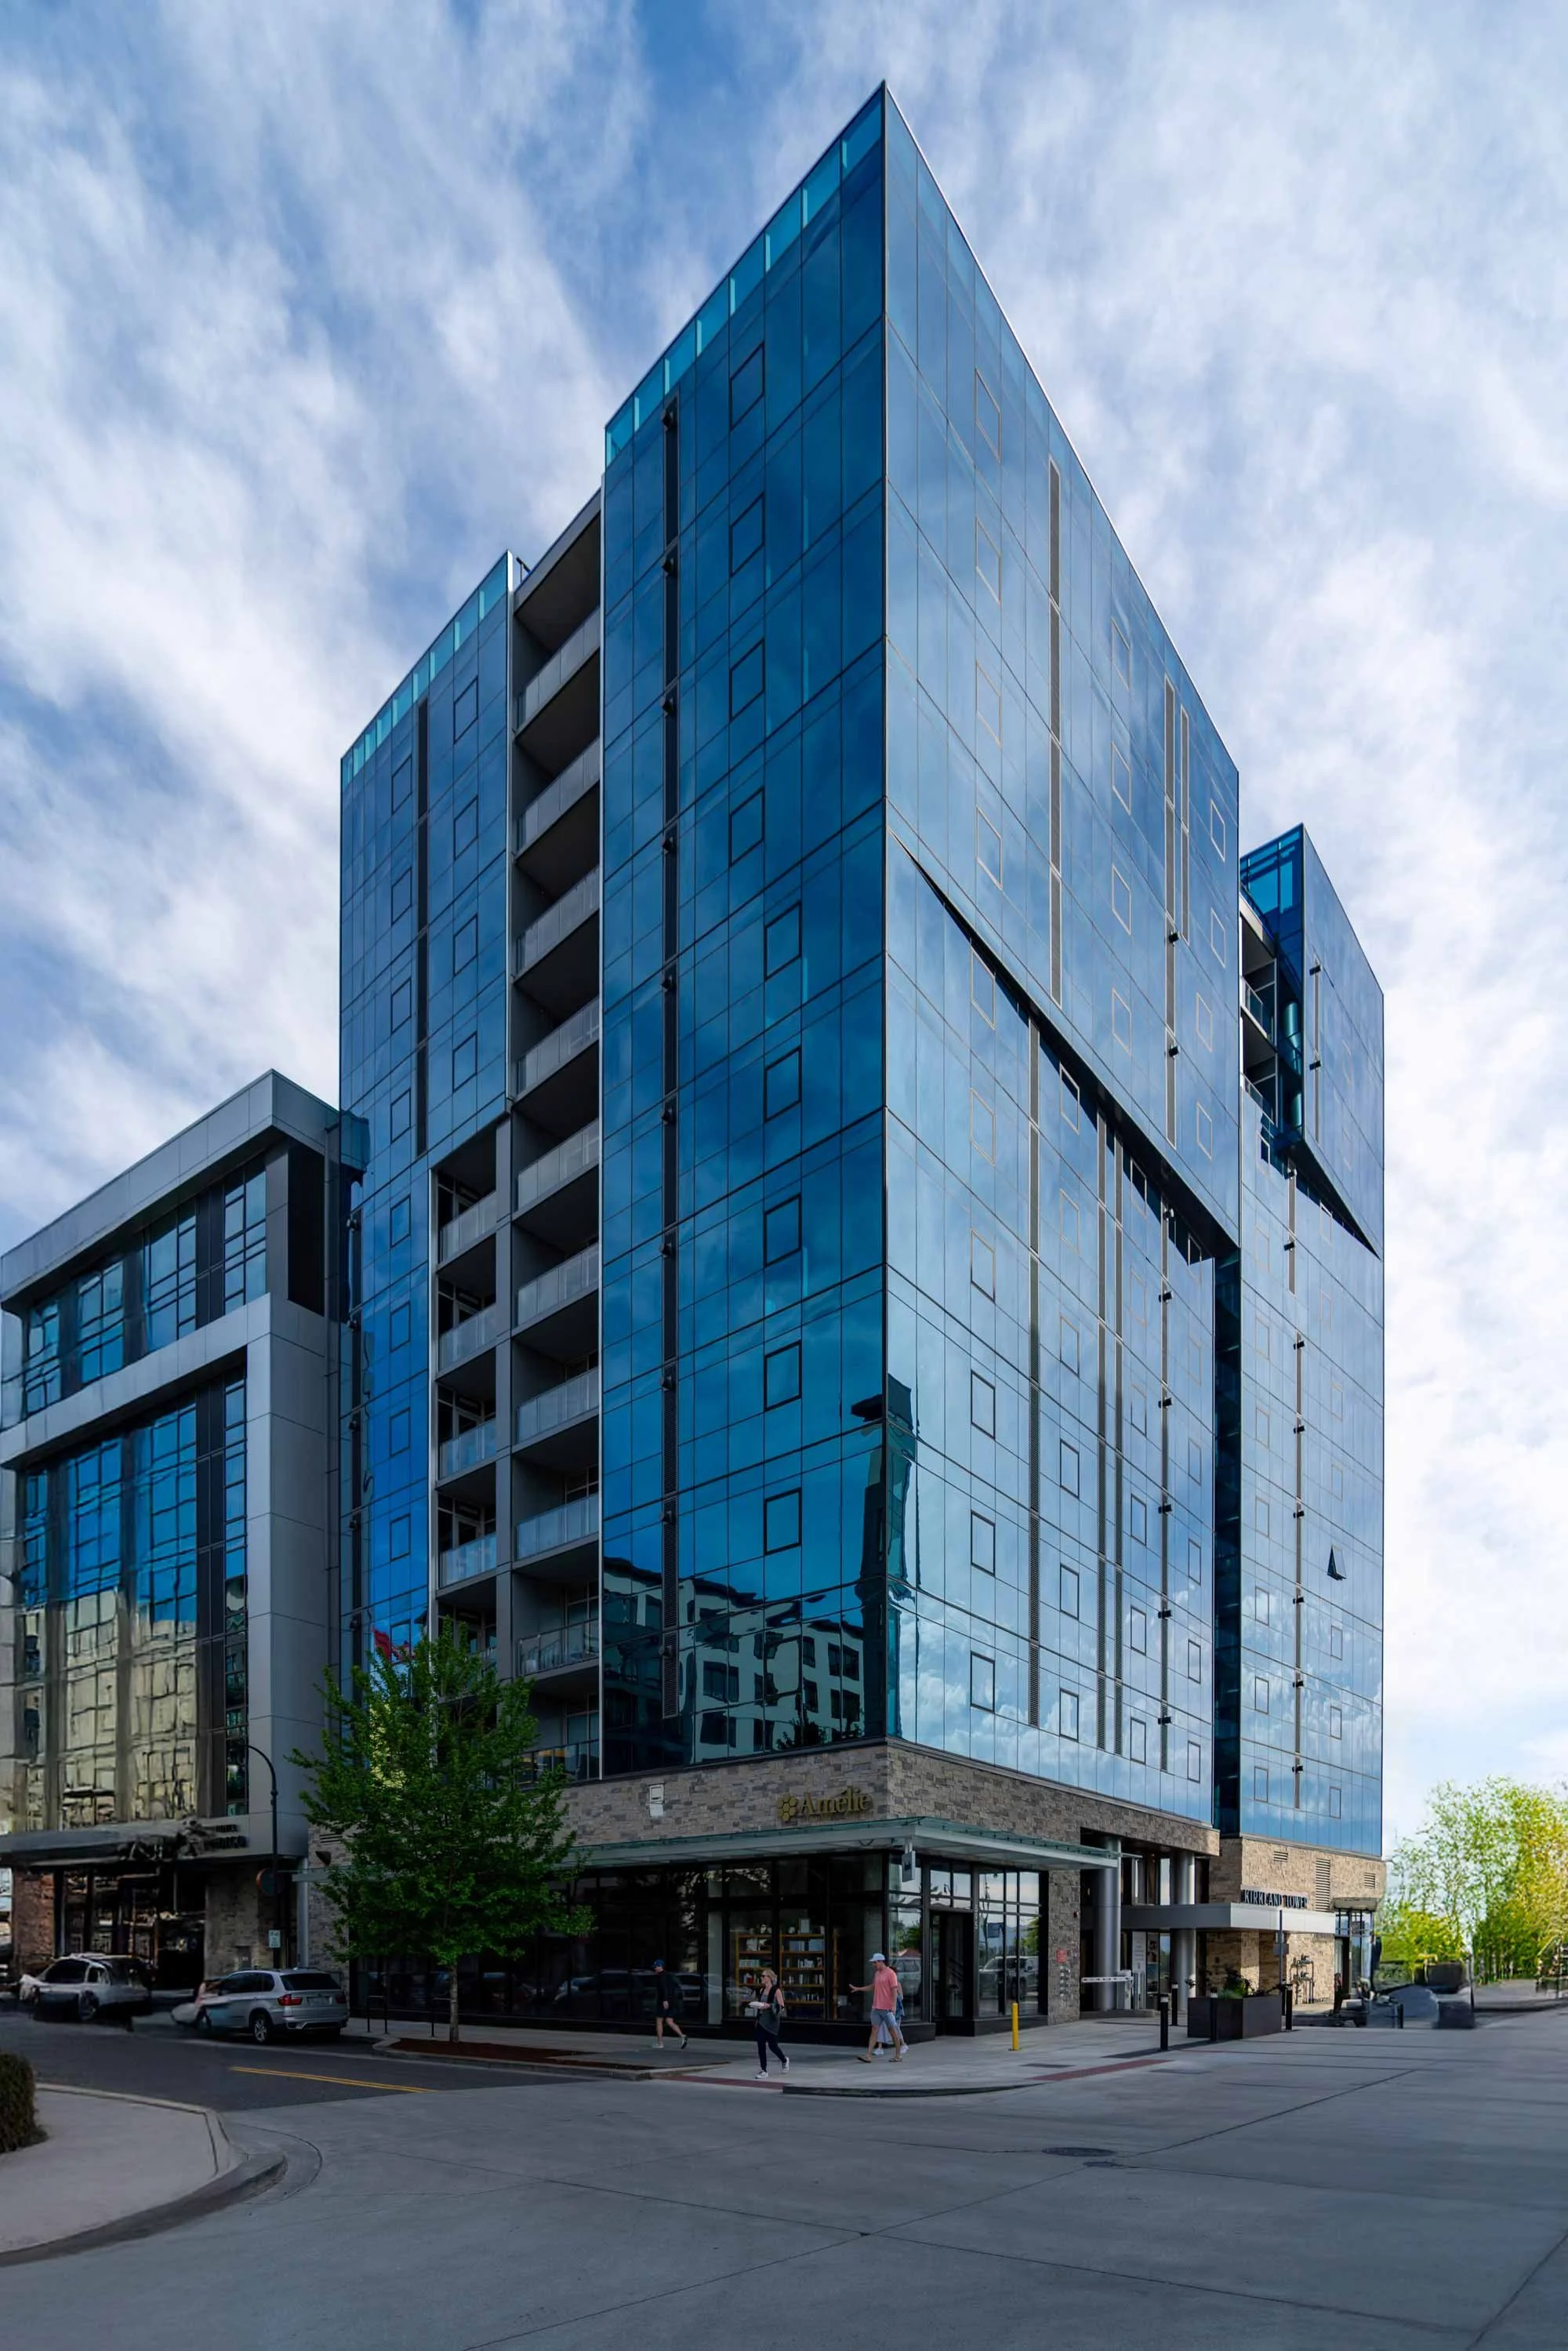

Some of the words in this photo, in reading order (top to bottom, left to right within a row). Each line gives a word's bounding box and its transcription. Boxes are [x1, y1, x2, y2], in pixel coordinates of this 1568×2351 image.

[799, 1785, 873, 1815] Amélie
[1241, 1889, 1282, 1907] KIRKLAND
[1283, 1894, 1308, 1910] TOWER
